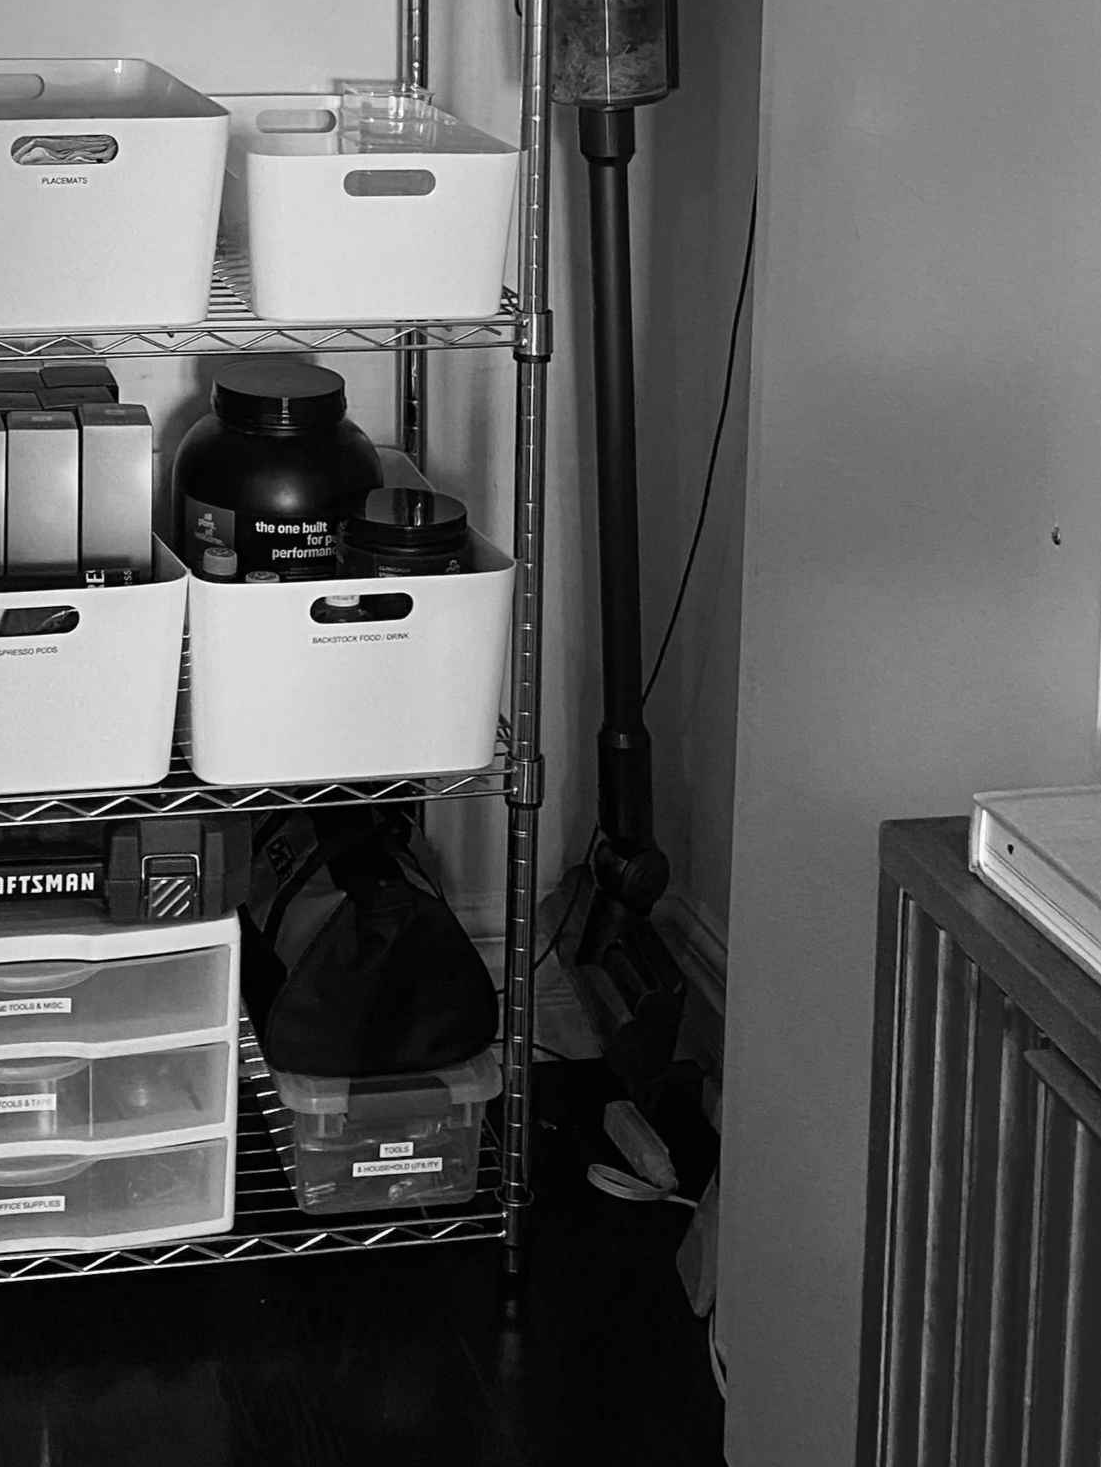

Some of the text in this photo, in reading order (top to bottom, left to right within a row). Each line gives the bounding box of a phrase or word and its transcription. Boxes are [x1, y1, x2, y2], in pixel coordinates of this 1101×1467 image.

[41, 177, 88, 185] PLACEMATS
[255, 521, 328, 534] the one built
[307, 534, 324, 546] for
[272, 546, 338, 560] performanc
[312, 635, 358, 644] BACKSTOCK
[359, 634, 382, 642] FOOD
[386, 633, 409, 641] DRINK
[35, 646, 58, 655] PODS
[9, 1003, 35, 1012] TOOLS
[24, 1099, 30, 1107] &
[383, 1145, 410, 1155] TOOLS
[356, 1160, 440, 1174] & HOUSEHOLD UTILITY
[22, 1199, 61, 1210] SUPPLIES
